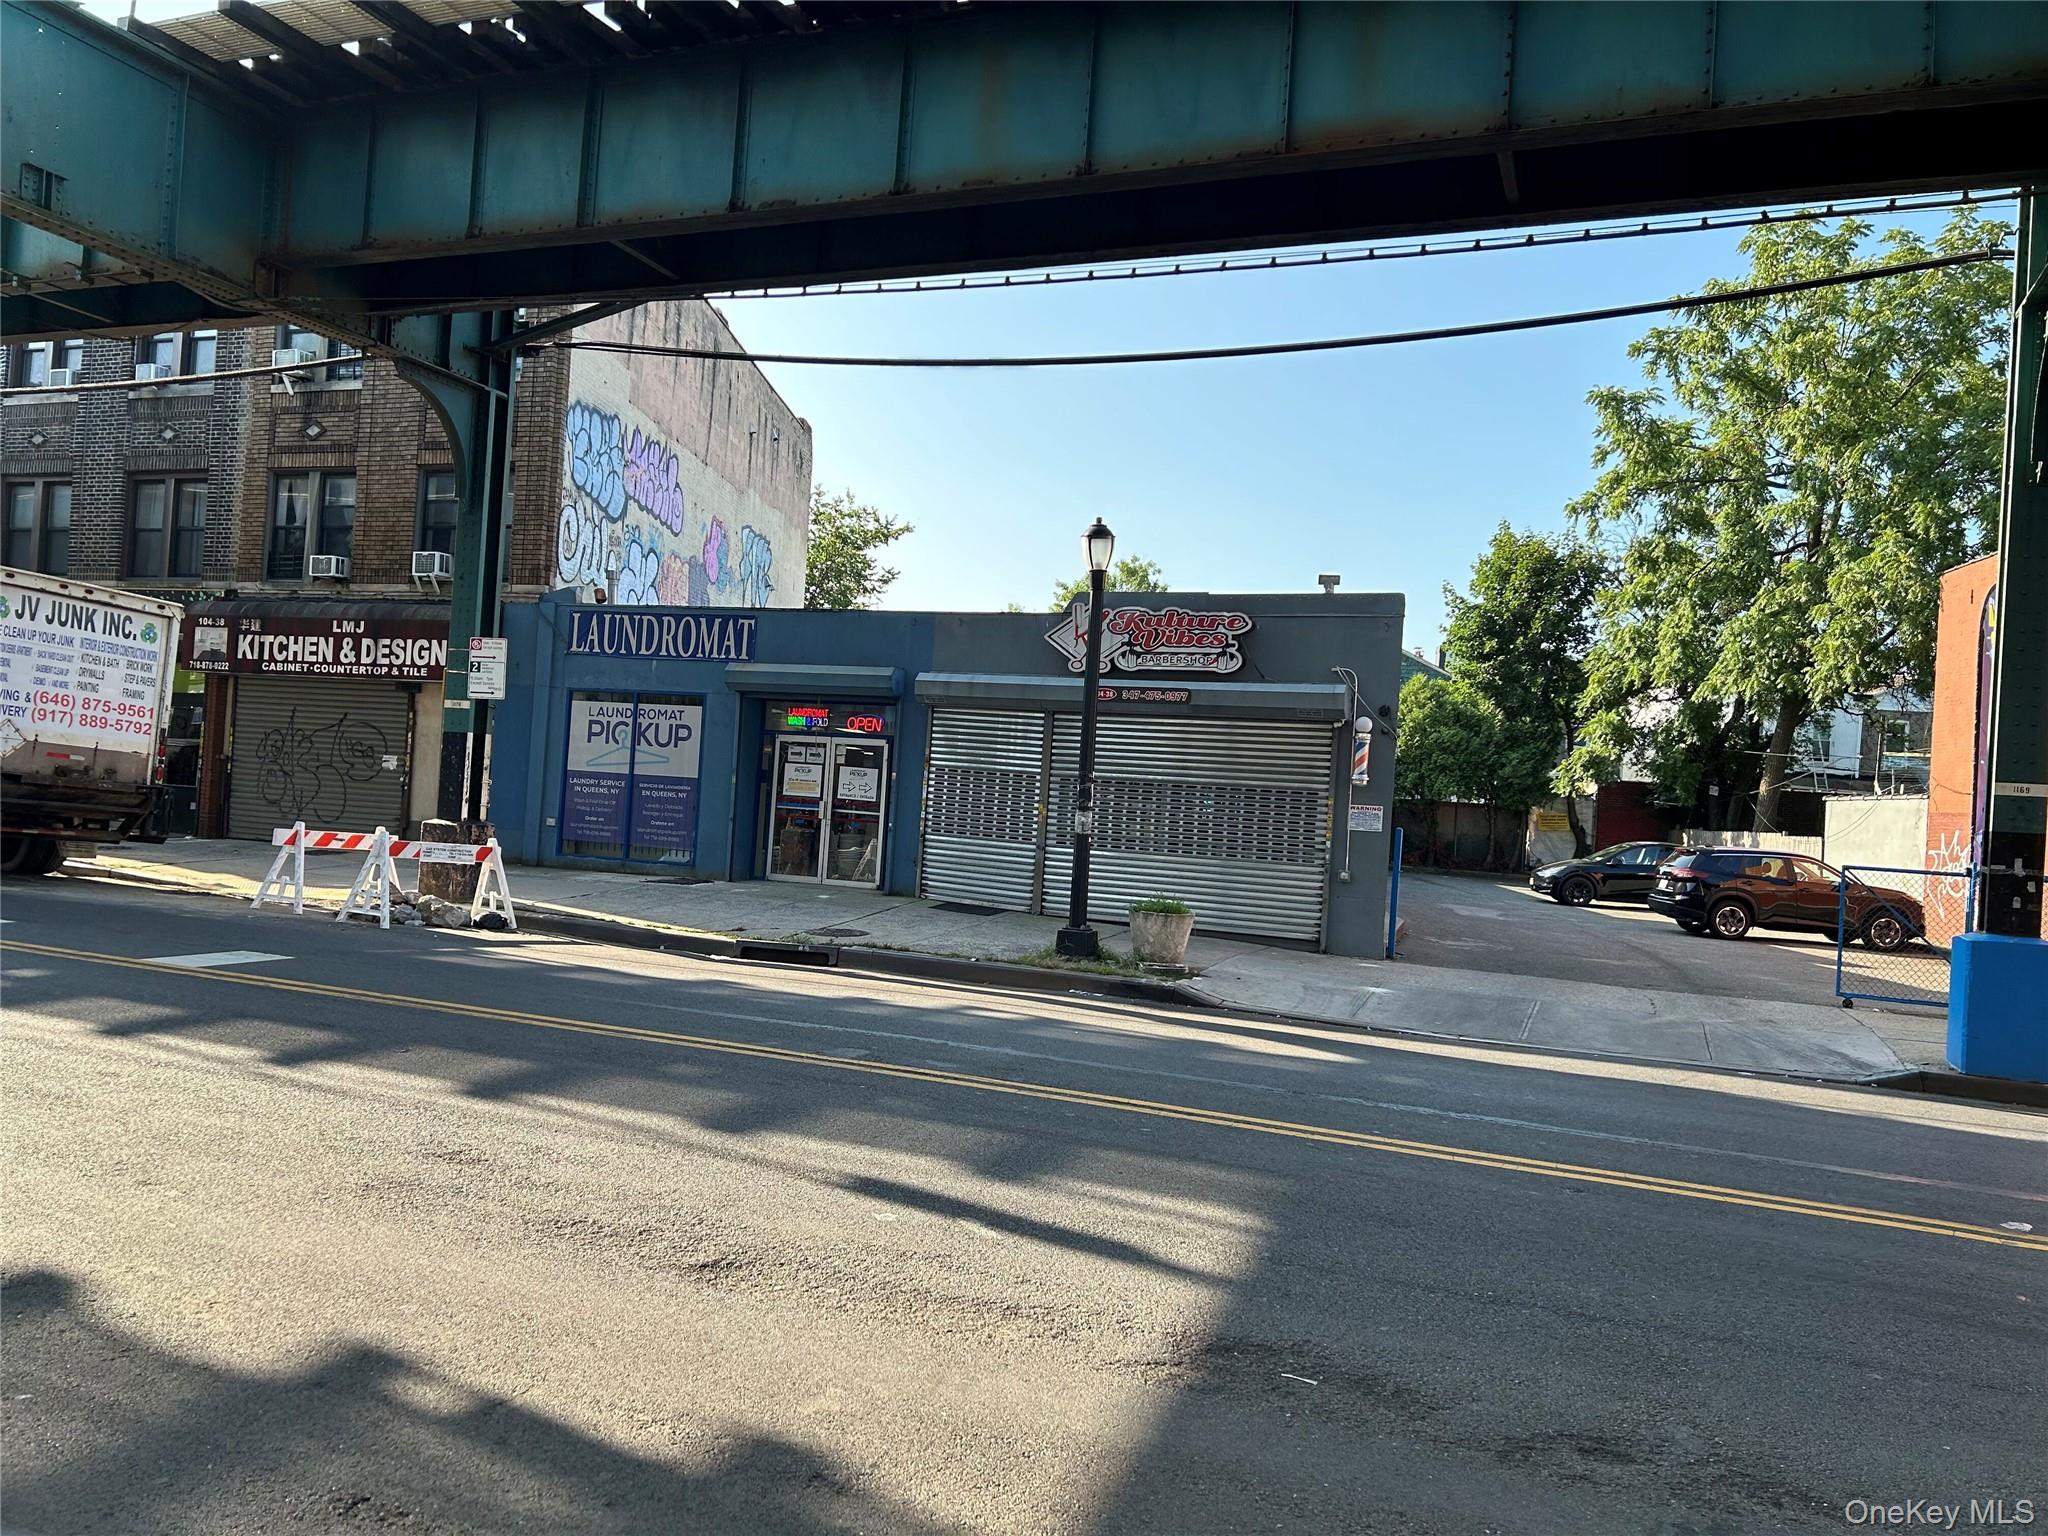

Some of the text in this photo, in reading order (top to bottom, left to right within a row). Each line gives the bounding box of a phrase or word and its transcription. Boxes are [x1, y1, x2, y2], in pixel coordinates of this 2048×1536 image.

[15, 594, 137, 641] JV JUNK INC.
[198, 617, 225, 626] 104-38
[1110, 610, 1246, 634] Kulture
[332, 620, 365, 633] LMJ
[3, 625, 75, 648] CLEAN UP YOUR JUNK
[570, 612, 755, 660] LAUNDROMAT
[1130, 628, 1227, 651] Vibes
[237, 634, 448, 666] KITCHEN & DESIGN
[81, 653, 101, 665] KITCHEN
[107, 657, 120, 669] BATH
[126, 659, 139, 671] BRICK
[471, 662, 478, 672] 2
[1141, 655, 1213, 665] BARBERSHOP
[78, 666, 105, 680] DRYWALLS
[262, 662, 428, 676] CABINET COUNTERTOP & TILE
[77, 680, 99, 693] PAINTING
[24, 691, 31, 703] &
[122, 688, 145, 700] FRAMING
[1121, 689, 1188, 701] 347-475-0977
[33, 689, 154, 719] (646) 875-9561
[589, 706, 685, 721] LAUNDROMAT
[32, 707, 152, 736] (917) 889-5792
[812, 717, 829, 727] FOLD
[847, 716, 882, 732] OPEN
[587, 719, 692, 748] PICKUP
[569, 777, 625, 787] LAUNDRY SERVICE
[582, 786, 609, 794] QUEENS,
